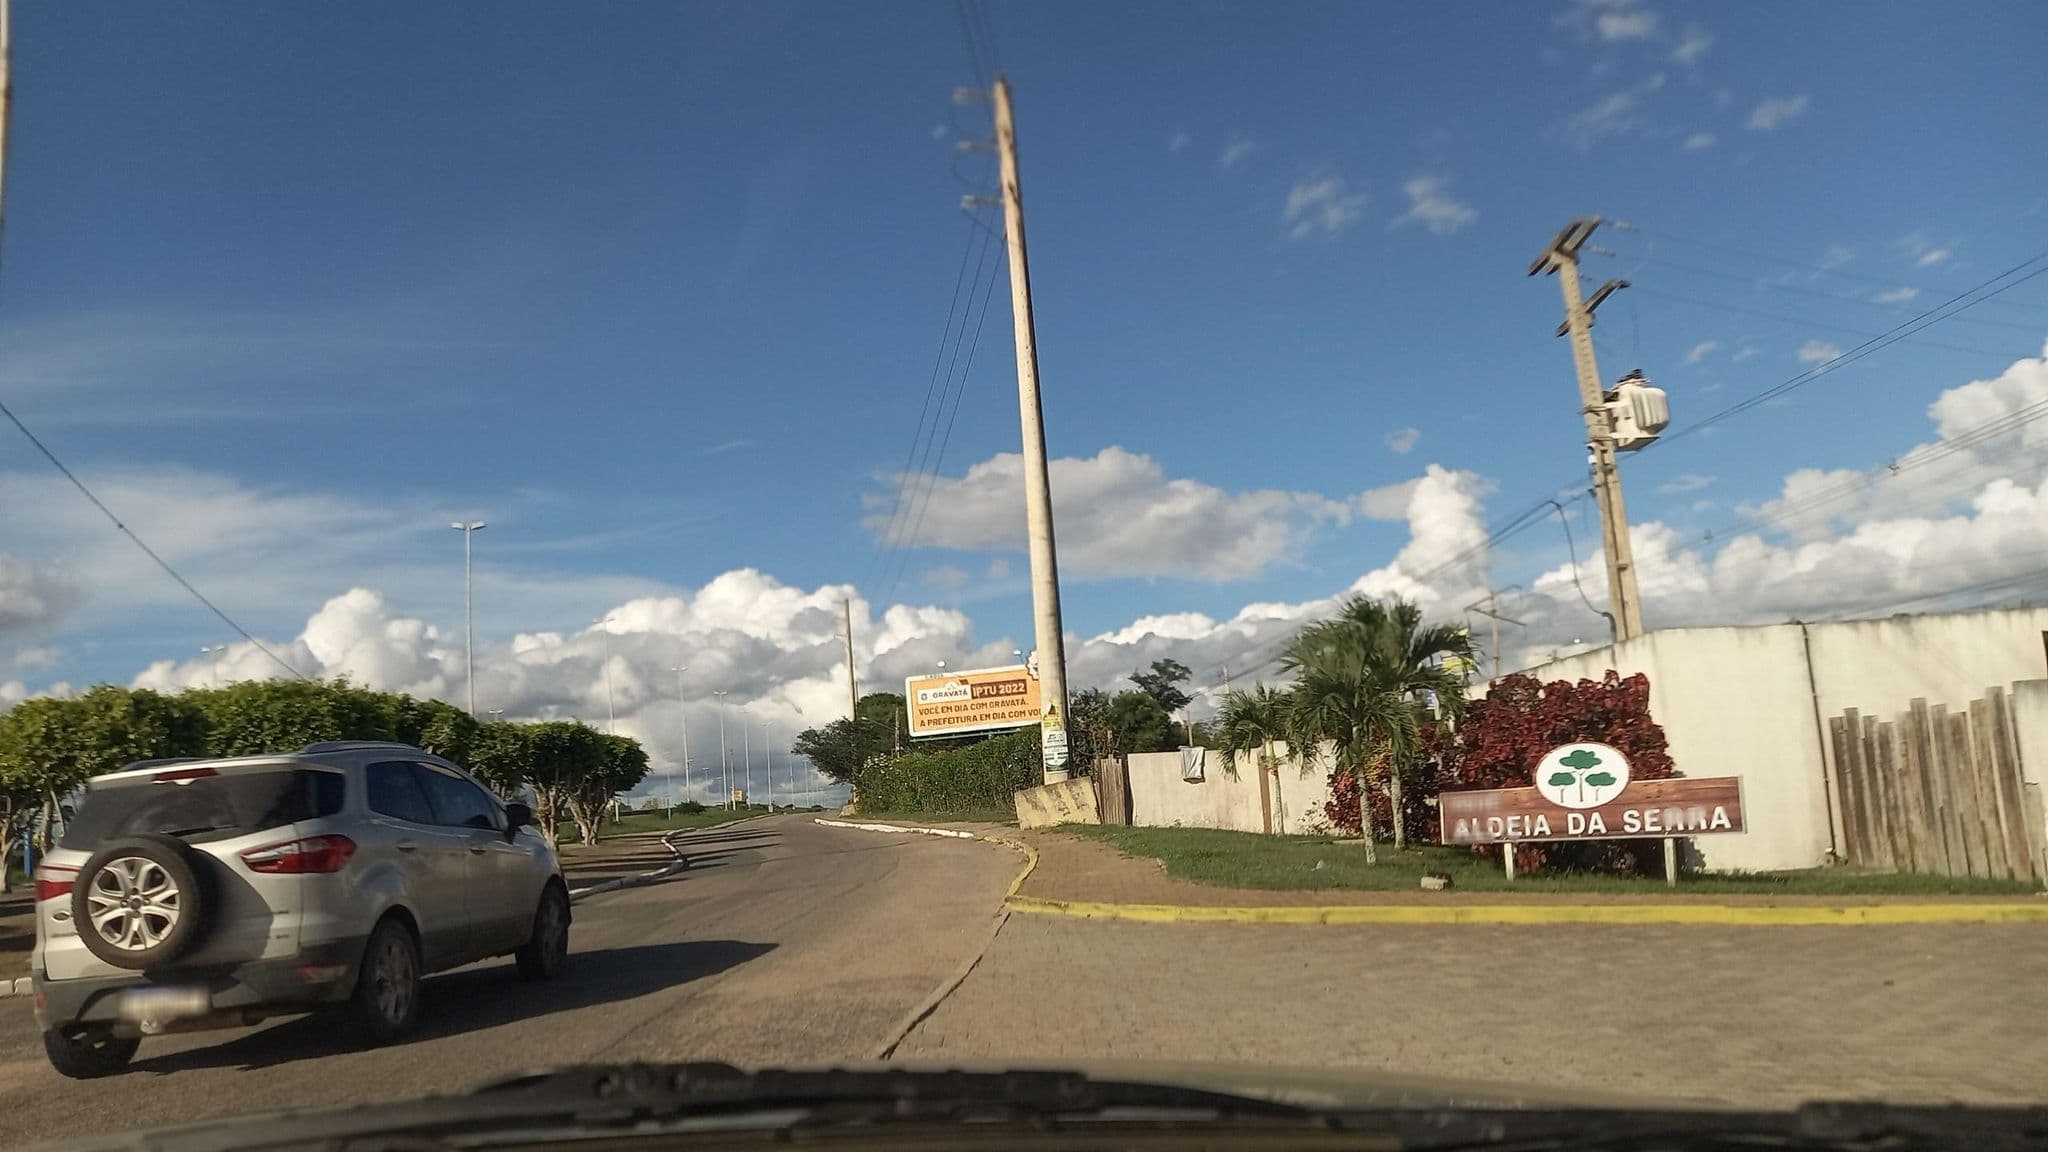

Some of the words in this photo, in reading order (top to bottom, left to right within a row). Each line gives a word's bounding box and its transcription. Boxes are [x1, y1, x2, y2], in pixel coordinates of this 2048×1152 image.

[972, 685, 997, 697] IPTU
[998, 682, 1026, 695] 2022
[918, 705, 940, 716] VOCÊ
[941, 705, 953, 714] EM
[954, 704, 969, 713] DIA
[970, 702, 988, 711] COM
[920, 719, 926, 727] A
[927, 714, 978, 727] PREFEITURA
[979, 713, 991, 721] EM
[992, 711, 1006, 720] DIA
[1008, 709, 1026, 718] COM
[1566, 811, 1608, 835] DA
